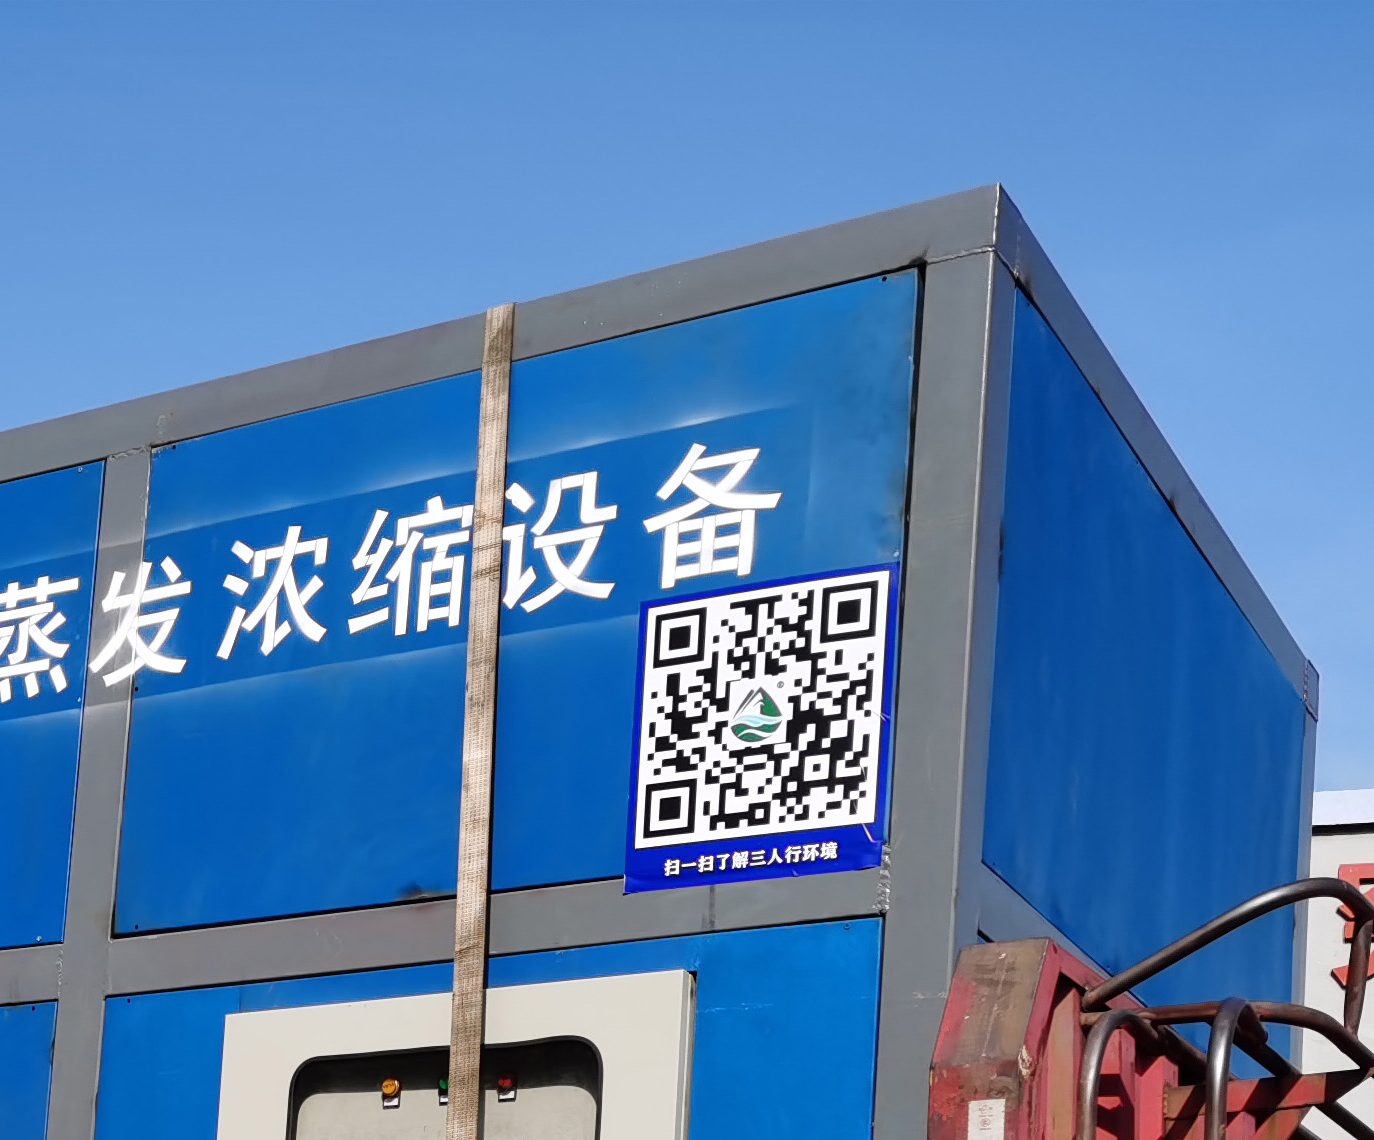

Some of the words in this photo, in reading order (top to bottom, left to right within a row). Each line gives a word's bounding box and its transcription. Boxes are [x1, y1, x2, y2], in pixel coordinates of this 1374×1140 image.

[664, 841, 838, 876] 扫一扫了解三人行环境
